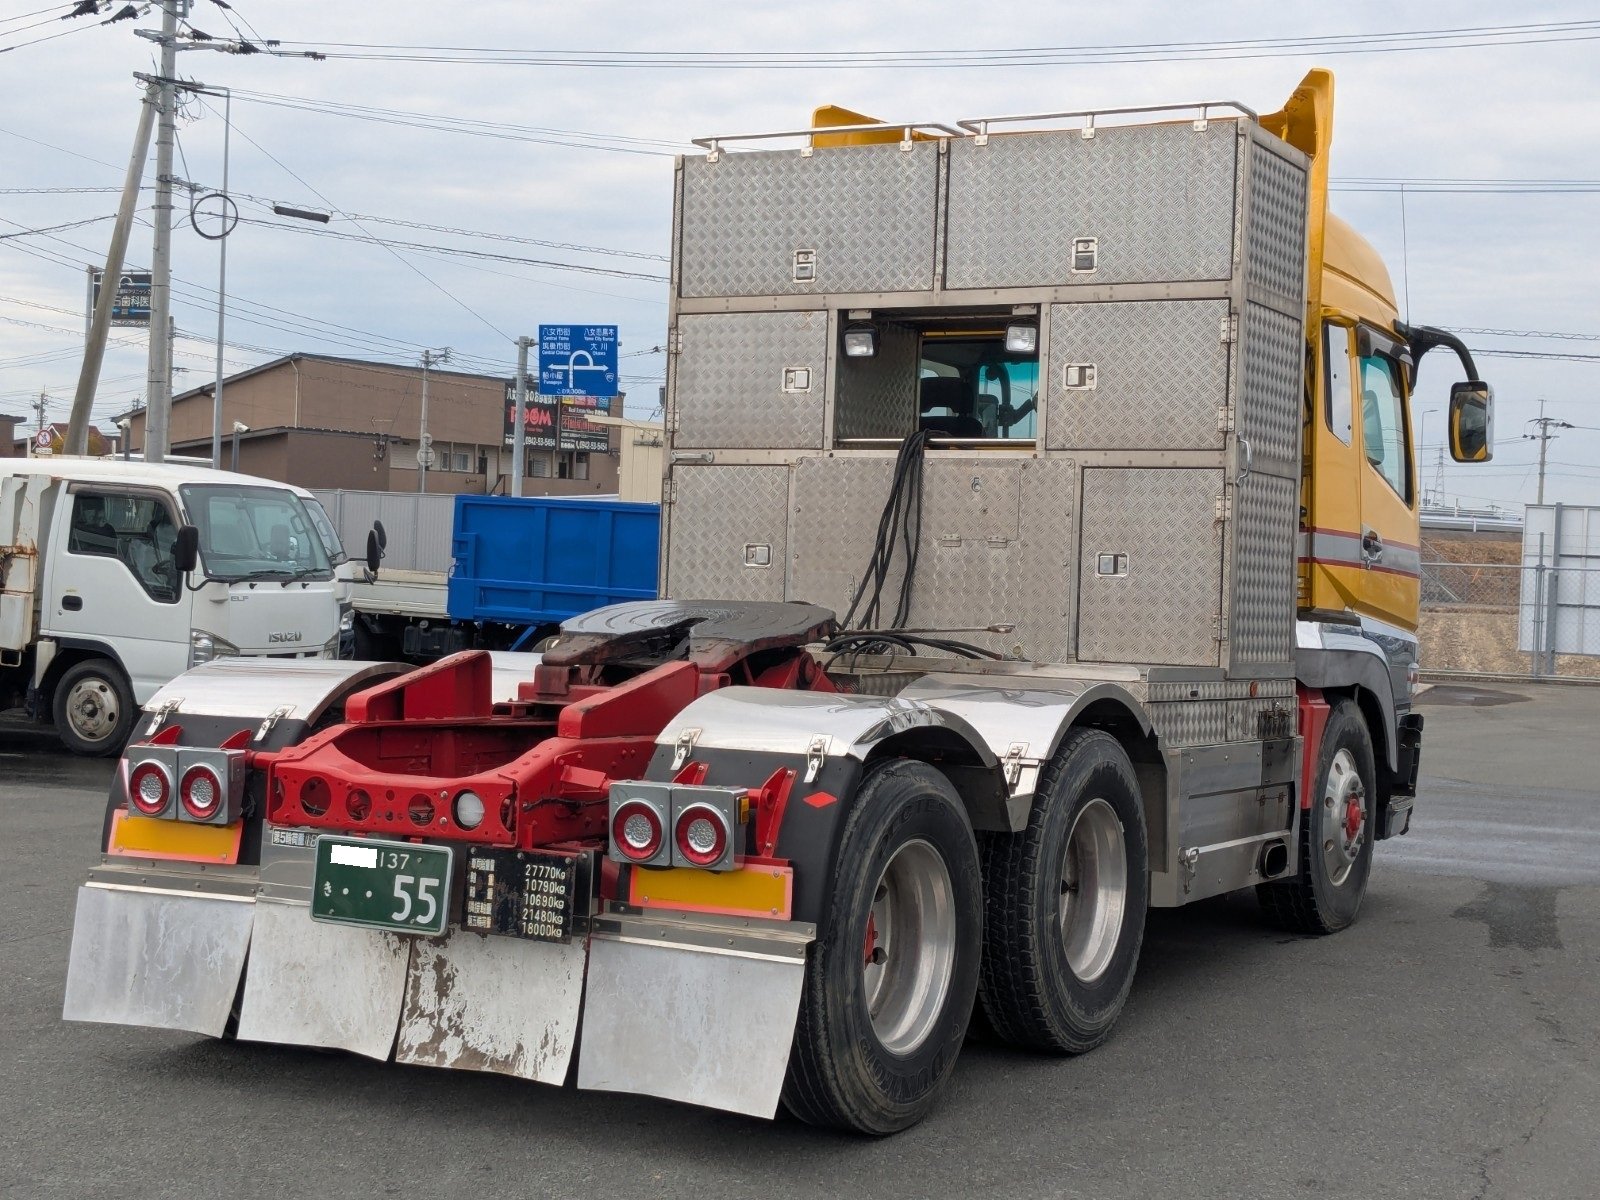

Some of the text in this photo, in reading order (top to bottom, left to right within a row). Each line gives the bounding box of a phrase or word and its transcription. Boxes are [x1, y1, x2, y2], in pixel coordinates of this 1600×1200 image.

[590, 343, 608, 351] 大川
[268, 631, 302, 643] ISUZU
[379, 851, 410, 870] 137
[525, 878, 566, 894] 10790kg
[523, 893, 565, 909] 10690kg
[522, 908, 564, 925] 21480kg
[522, 921, 563, 938] 18000kg
